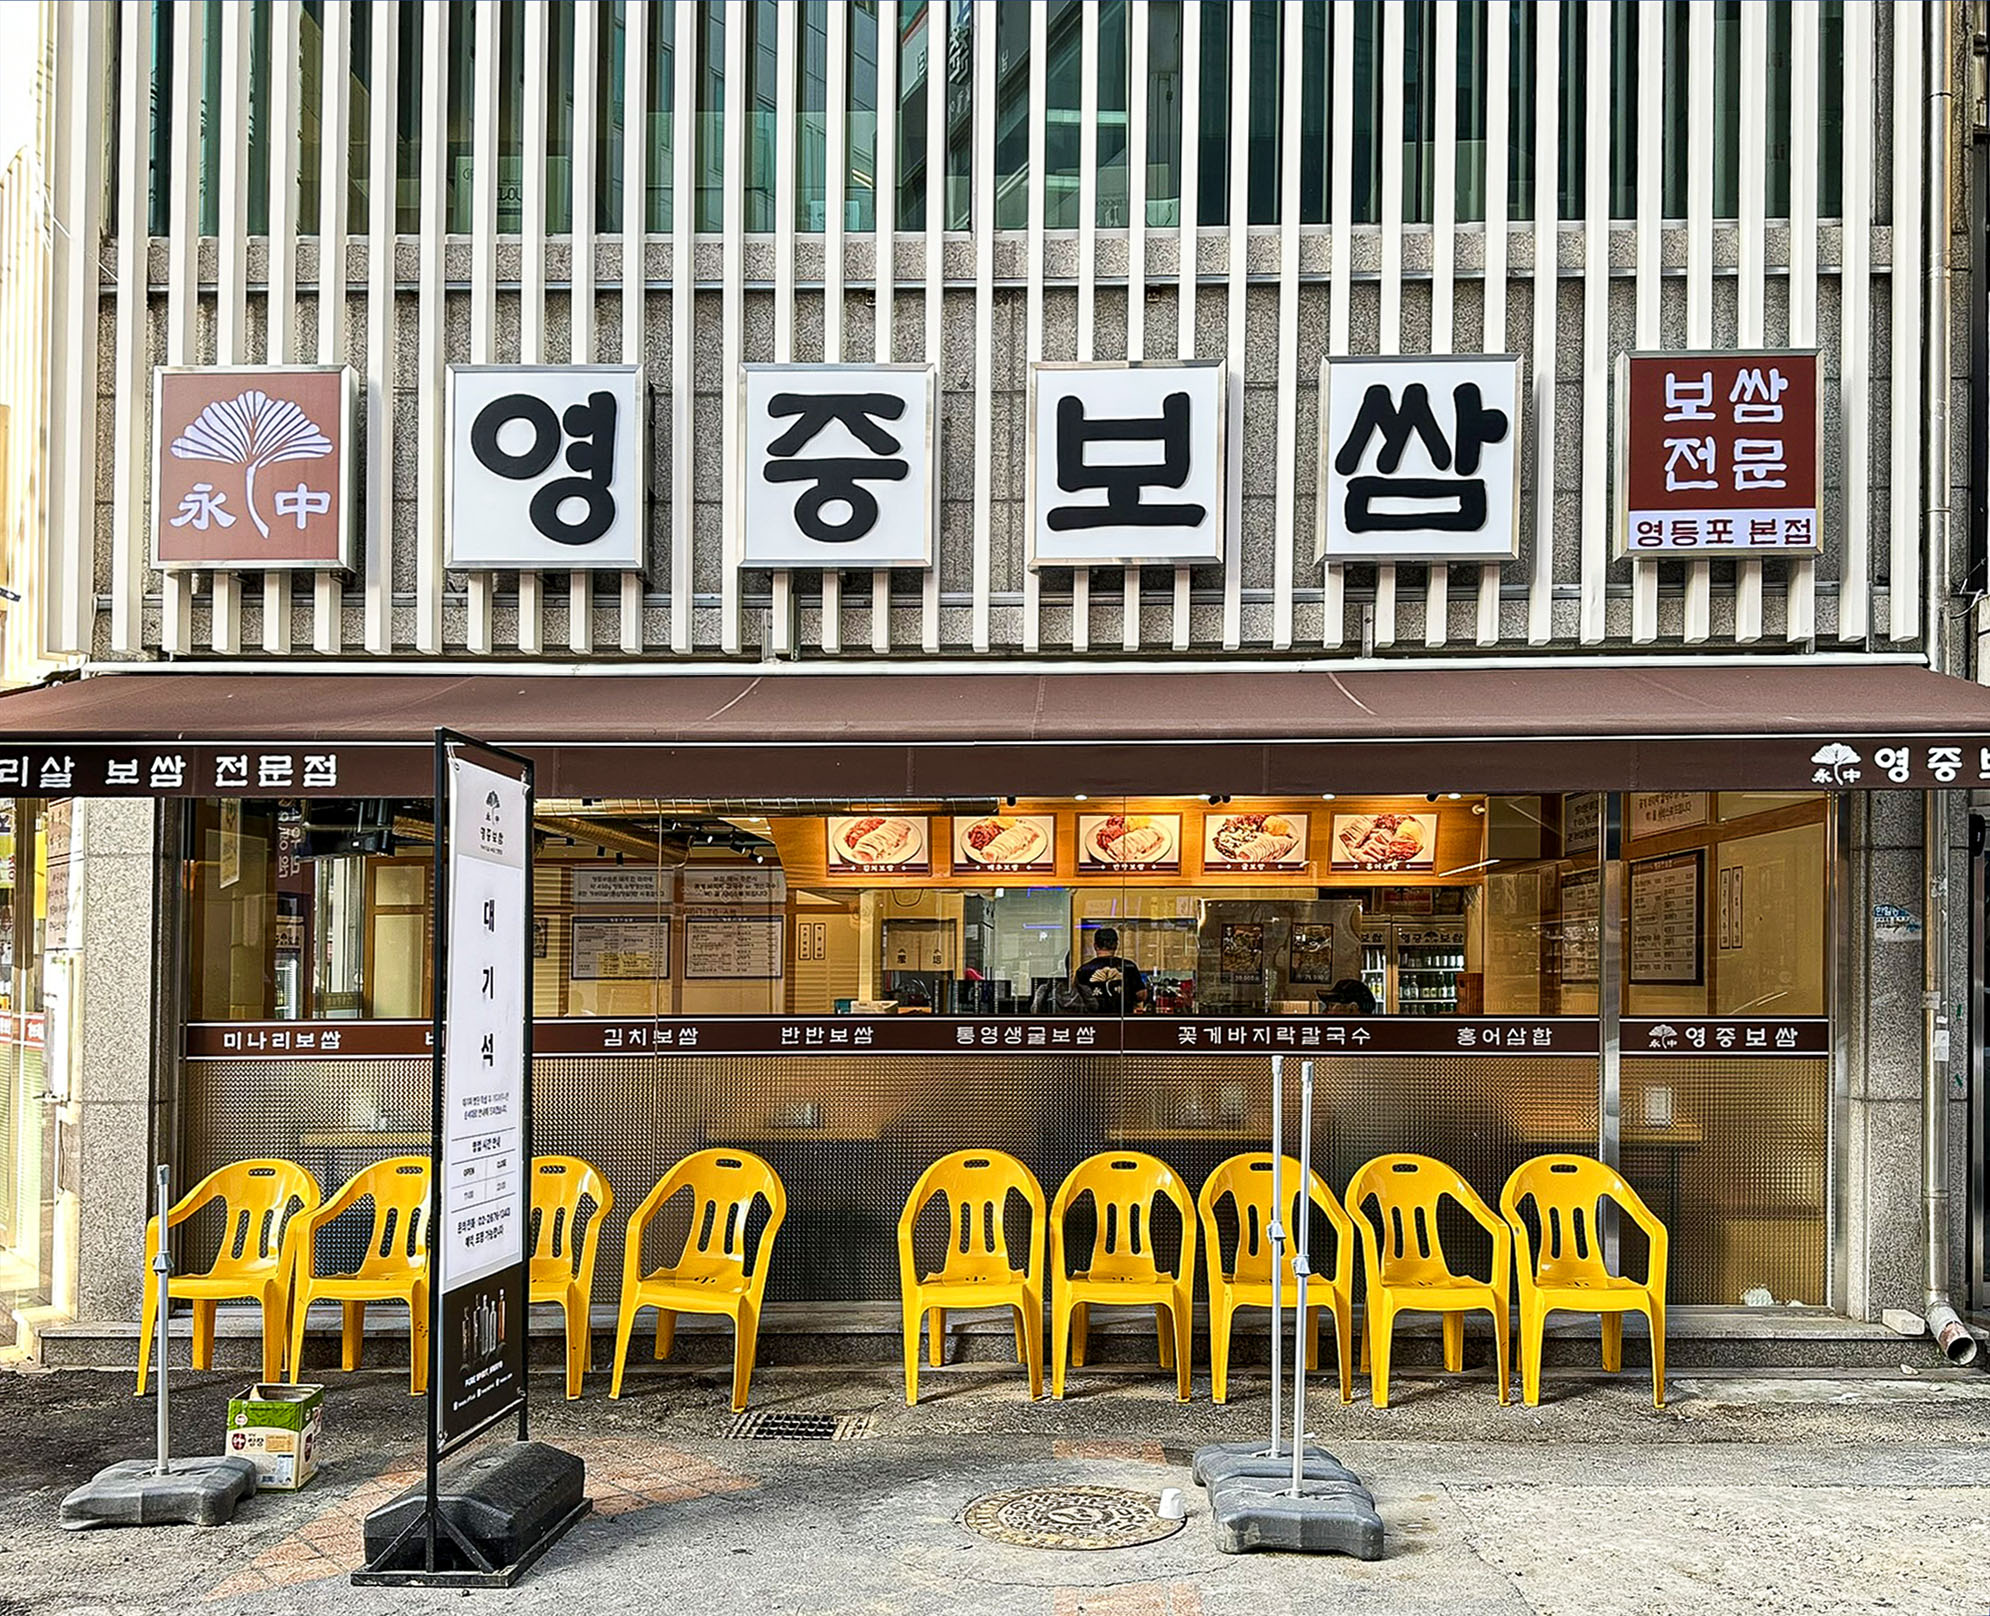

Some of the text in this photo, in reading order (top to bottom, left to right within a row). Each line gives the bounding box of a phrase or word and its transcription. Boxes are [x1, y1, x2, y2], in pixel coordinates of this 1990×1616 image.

[1663, 368, 1789, 425] 보쌈
[1663, 437, 1788, 492] 전문
[1636, 517, 1812, 547] 영등포 본점
[105, 755, 187, 788] 보쌈
[215, 753, 338, 788] 전문점
[223, 1030, 342, 1050] 미나리보쌈
[603, 1028, 699, 1048] 김치보쌈
[781, 1026, 874, 1045] 반반보쌈
[956, 1026, 1096, 1046] 통영생굴보쌈
[1178, 1026, 1371, 1046] 꽃게바지락칼국수
[1456, 1026, 1553, 1046] 홍어삼합
[1685, 1026, 1798, 1047] 영중보쌈
